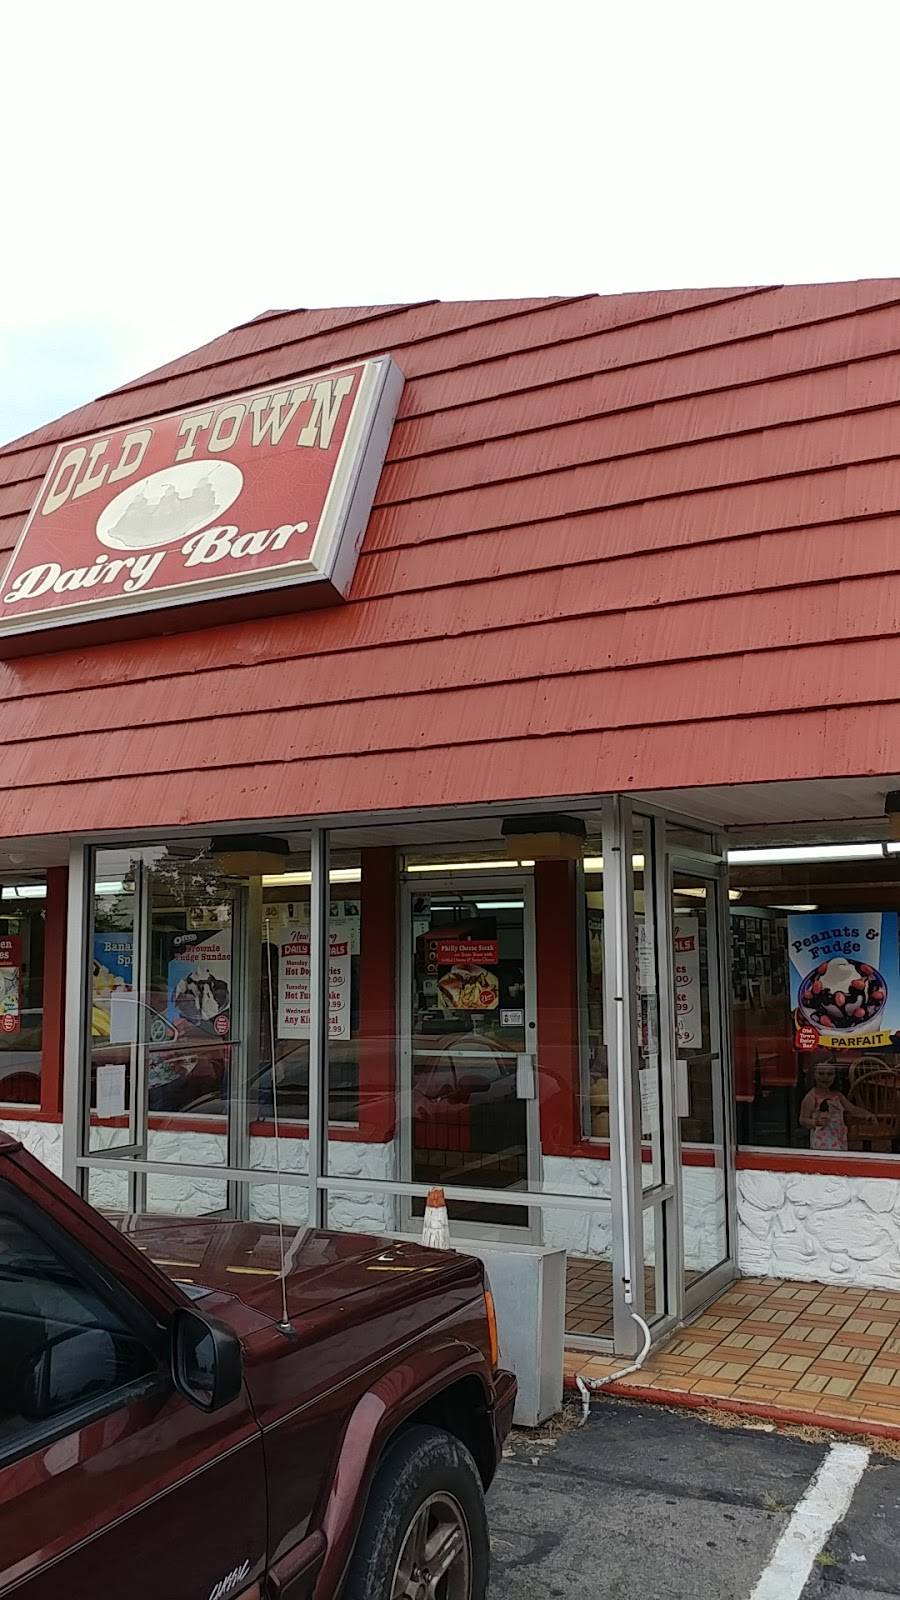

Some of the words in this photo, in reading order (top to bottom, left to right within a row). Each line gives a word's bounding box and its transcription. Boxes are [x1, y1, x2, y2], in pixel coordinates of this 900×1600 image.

[41, 428, 155, 517] OLD
[175, 374, 356, 462] TOWN
[4, 552, 167, 603] Dairy
[181, 521, 309, 568] Bar
[791, 926, 860, 953] Peanuts
[865, 928, 879, 940] &
[284, 945, 308, 955] DAILY
[808, 940, 861, 960] Fudge
[285, 967, 298, 976] Hot
[285, 991, 298, 1000] Hot
[284, 1016, 298, 1025] Any
[831, 1034, 884, 1046] PARFAIT
